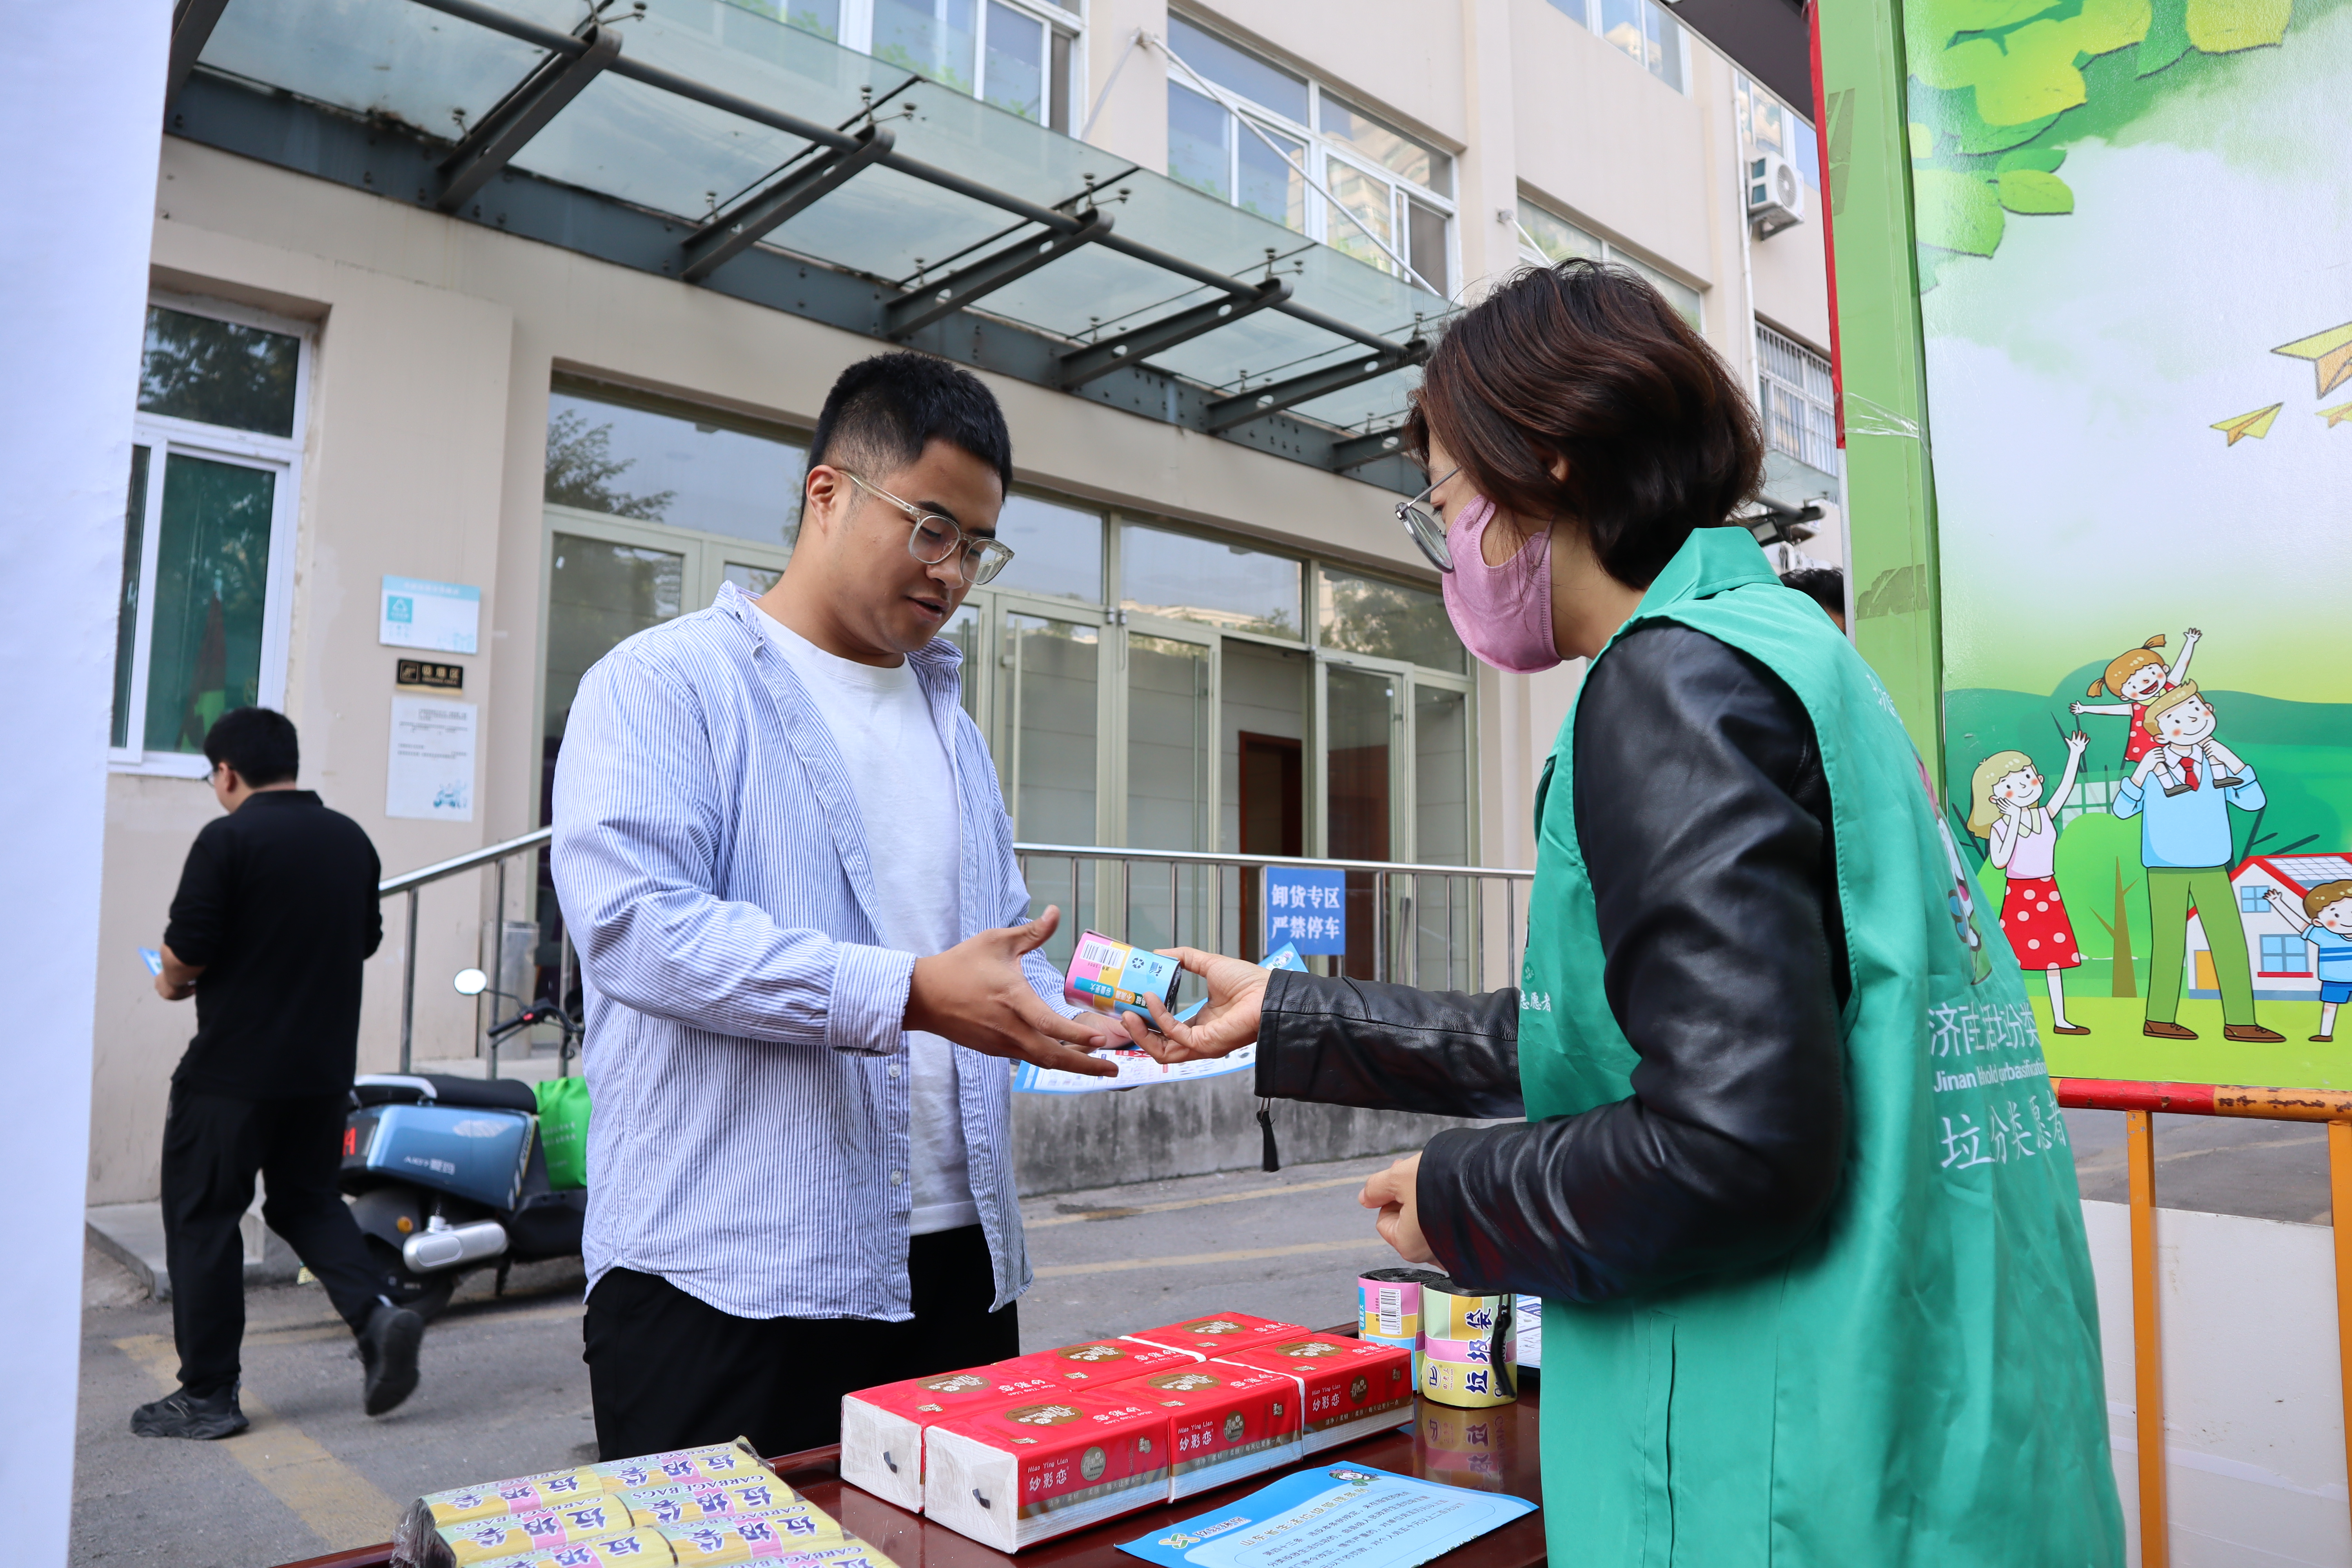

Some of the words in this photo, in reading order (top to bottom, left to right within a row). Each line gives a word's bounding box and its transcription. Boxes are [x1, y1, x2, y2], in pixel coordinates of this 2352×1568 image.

[1271, 884, 1341, 909] 卸货专区
[1271, 915, 1340, 940] 严禁停车
[1934, 1067, 1977, 1093] Jinan
[1465, 1308, 1492, 1394] 垃圾袋
[1179, 1430, 1212, 1452] 妙影恋
[610, 1454, 735, 1486] 垃圾袋
[1028, 1465, 1040, 1474] Miao
[1057, 1457, 1069, 1466] Lian
[445, 1475, 579, 1509] 垃圾袋
[632, 1486, 679, 1499] BAGS
[683, 1475, 765, 1492] GARBAGE
[1029, 1468, 1067, 1492] 妙影恋
[512, 1497, 602, 1520] GARBAGE
[642, 1486, 772, 1524] 垃圾袋
[1240, 1488, 1371, 1546] 山东省生活垃圾管理条例
[456, 1516, 507, 1532] BAGS
[465, 1507, 606, 1548] 垃圾袋
[681, 1516, 817, 1553] 垃圾袋
[774, 1546, 863, 1565] GARBAGE
[1263, 1538, 1305, 1556] 第四十三条
